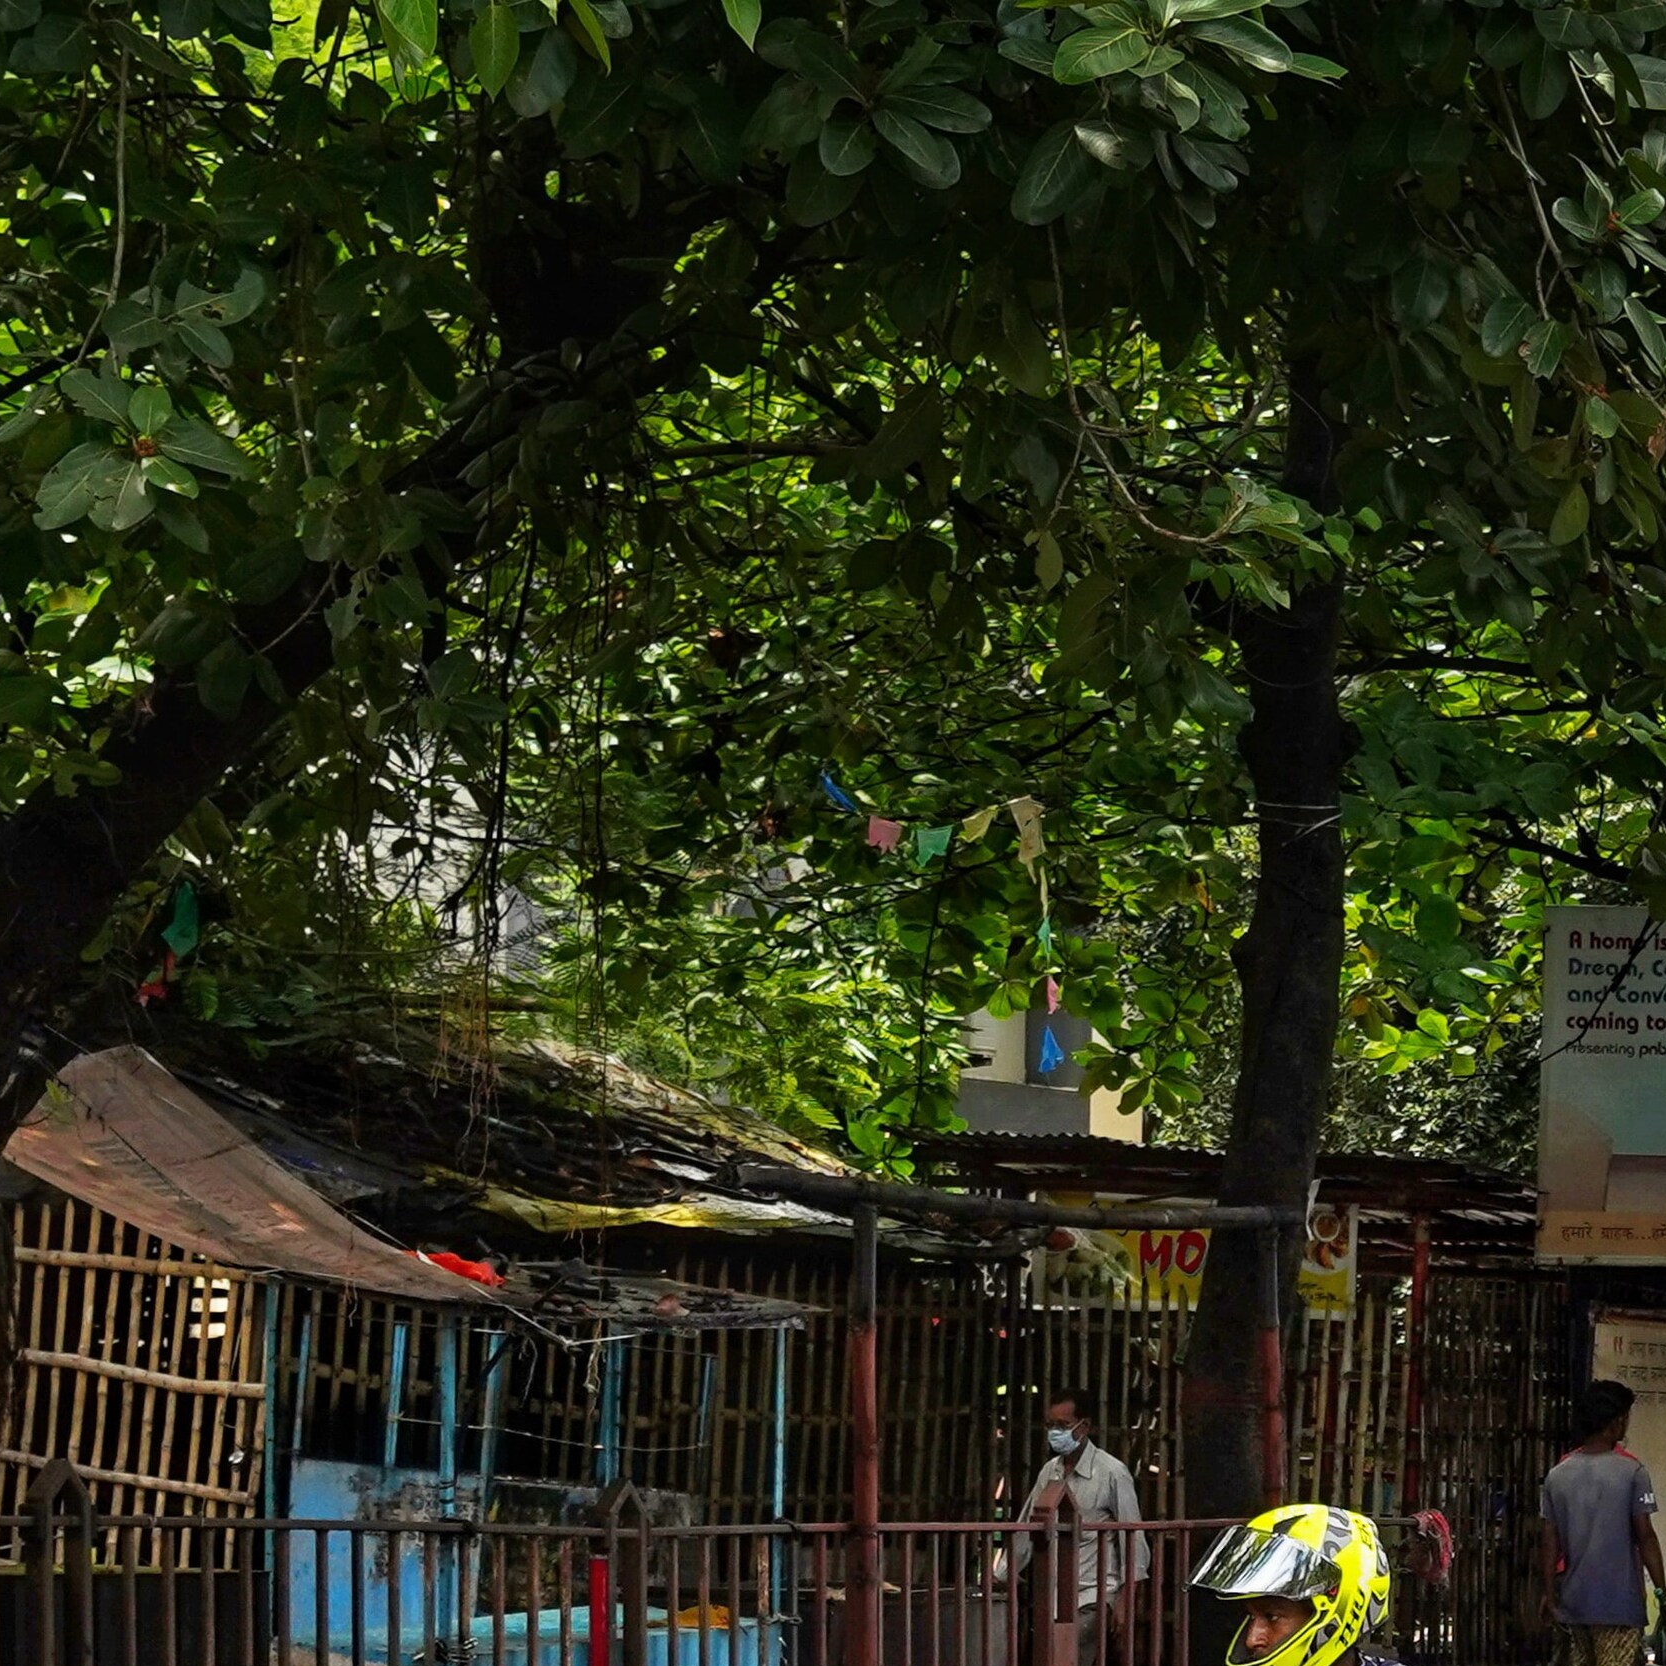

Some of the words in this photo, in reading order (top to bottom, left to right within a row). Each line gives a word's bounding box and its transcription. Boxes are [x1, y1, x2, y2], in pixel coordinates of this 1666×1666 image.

[1569, 930, 1582, 949] A
[1566, 1012, 1639, 1034] coming
[1565, 1042, 1635, 1057] Presenting
